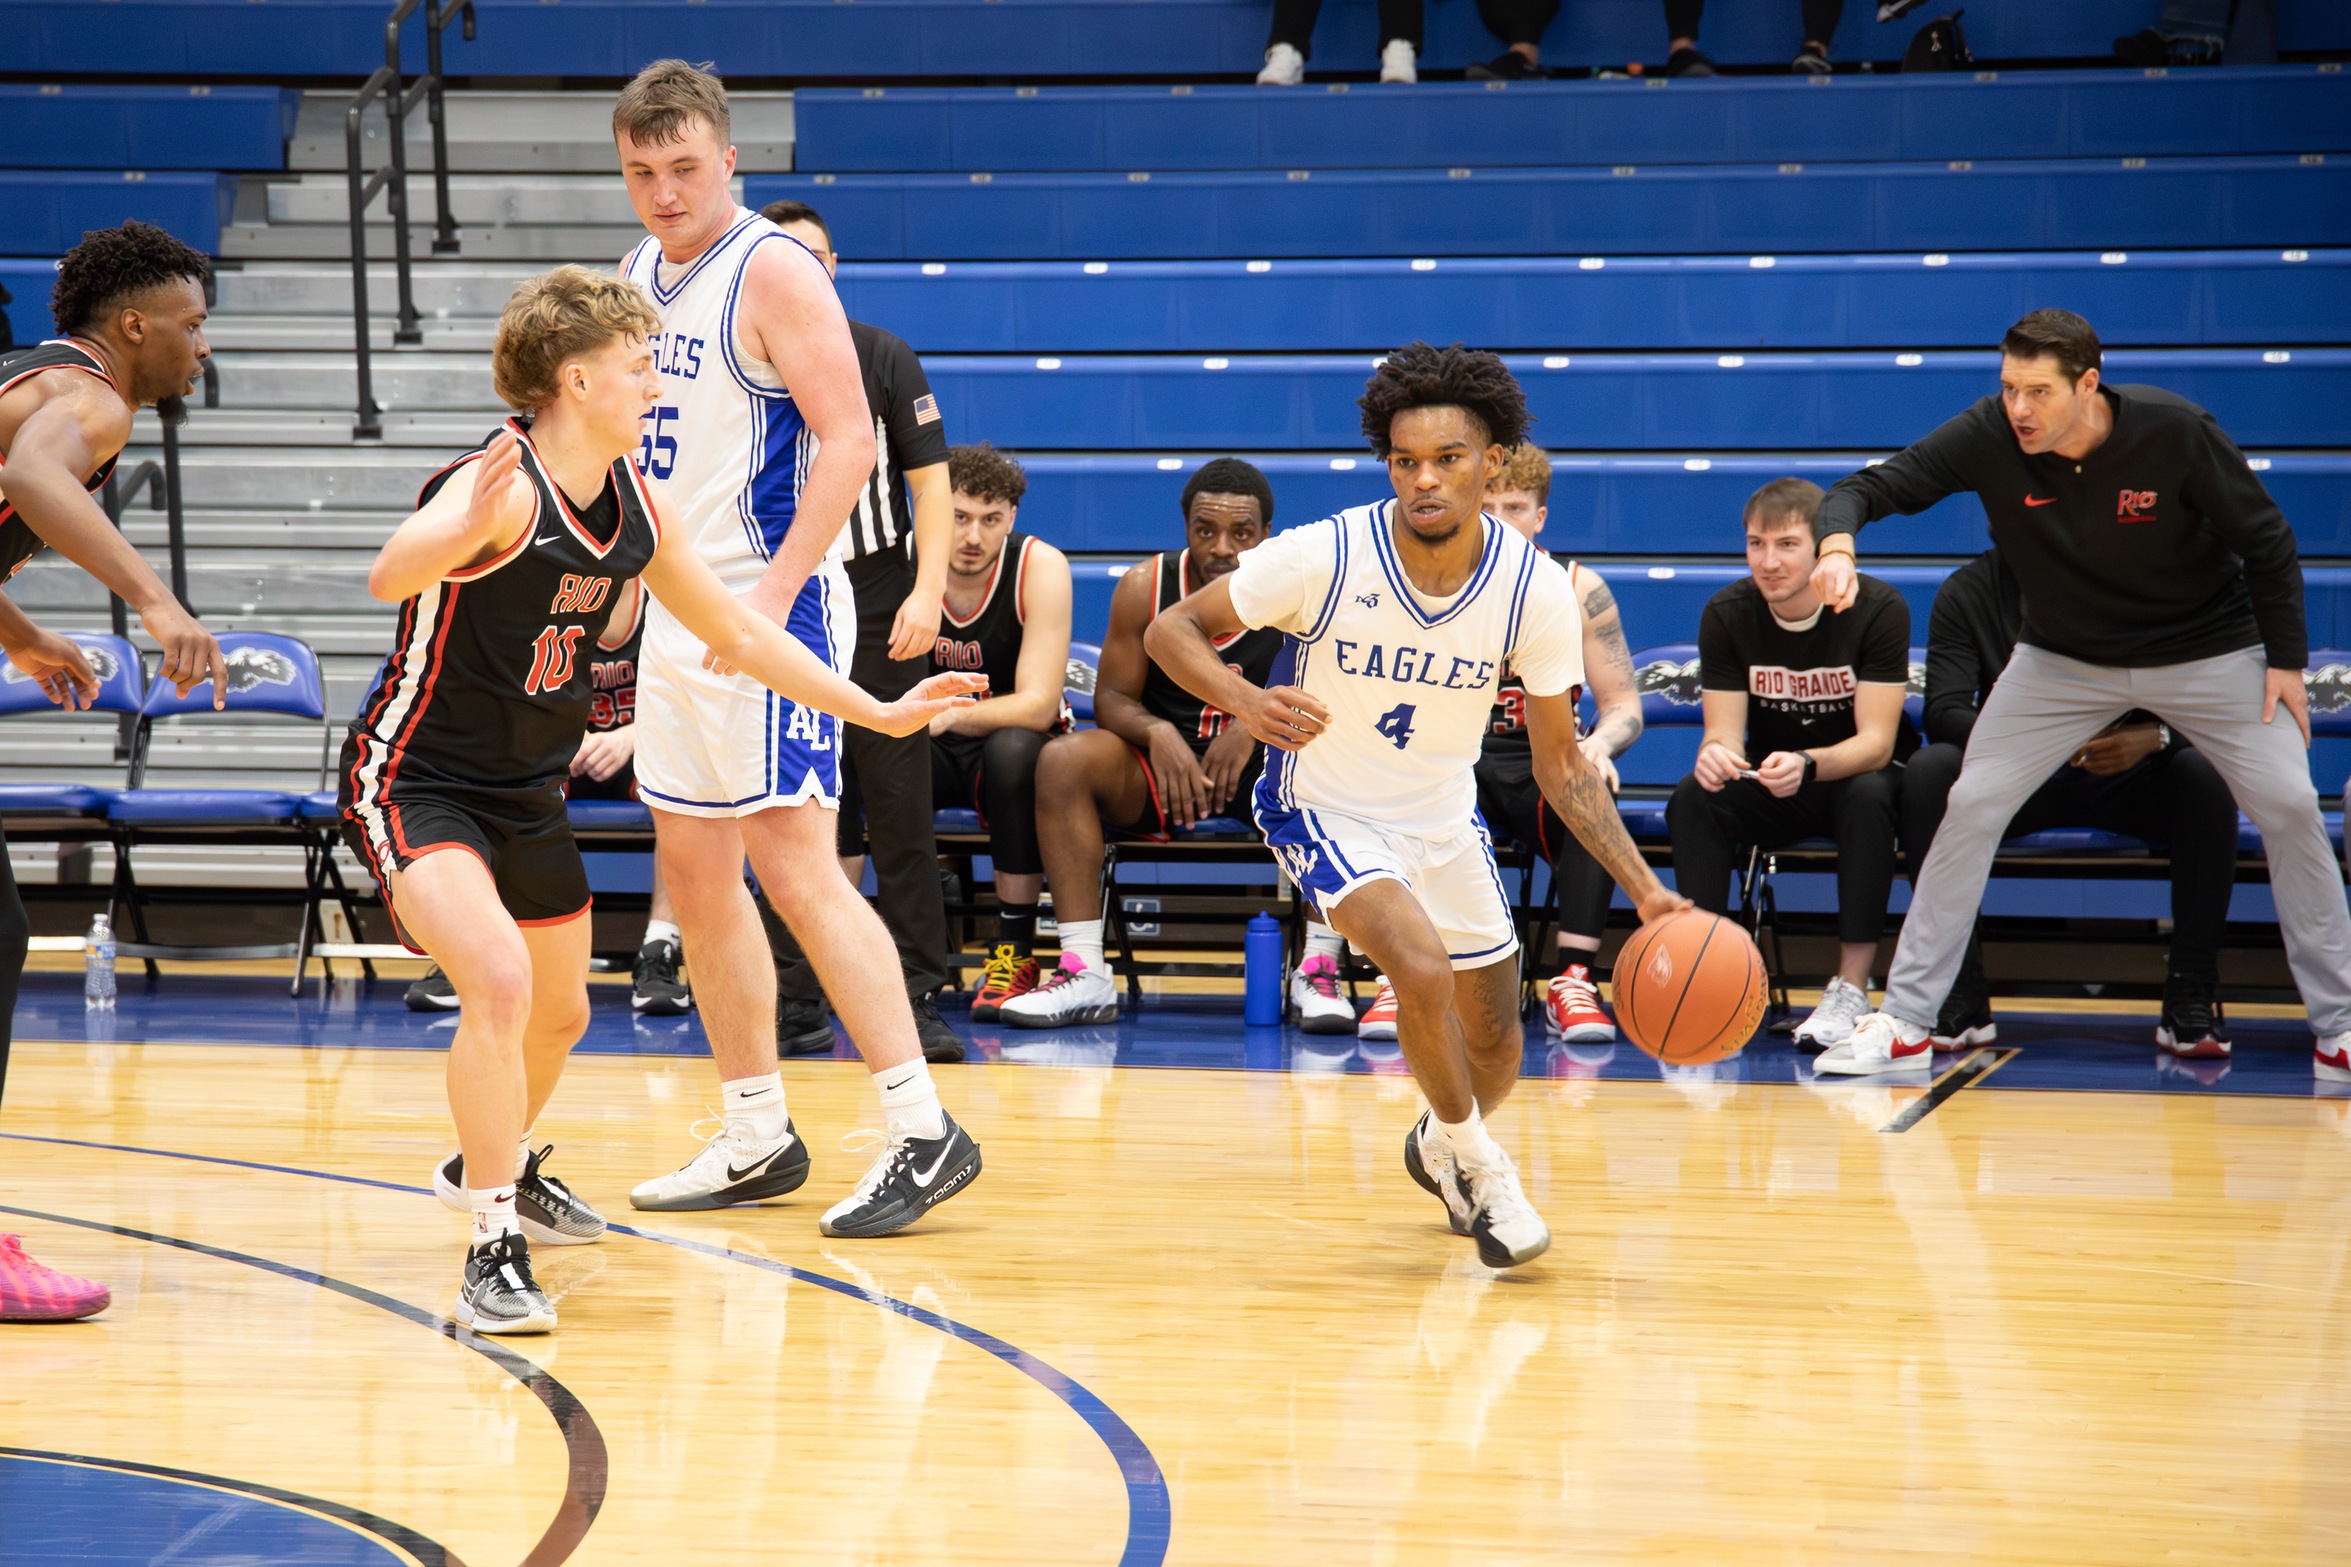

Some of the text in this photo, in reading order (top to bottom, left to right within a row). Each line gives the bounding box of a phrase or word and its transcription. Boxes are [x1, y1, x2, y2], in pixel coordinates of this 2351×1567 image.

[648, 333, 704, 380] GLES
[636, 406, 679, 480] 55
[550, 573, 612, 614] RIO
[525, 625, 585, 695] 10
[590, 660, 635, 690] RIO
[935, 635, 984, 670] RIO
[1335, 639, 1494, 689] EAGLES
[1755, 670, 1854, 698] RIO GRANDE
[588, 687, 636, 729] 35
[786, 702, 831, 751] AL
[1374, 702, 1417, 750] 4
[1484, 686, 1527, 735] 3
